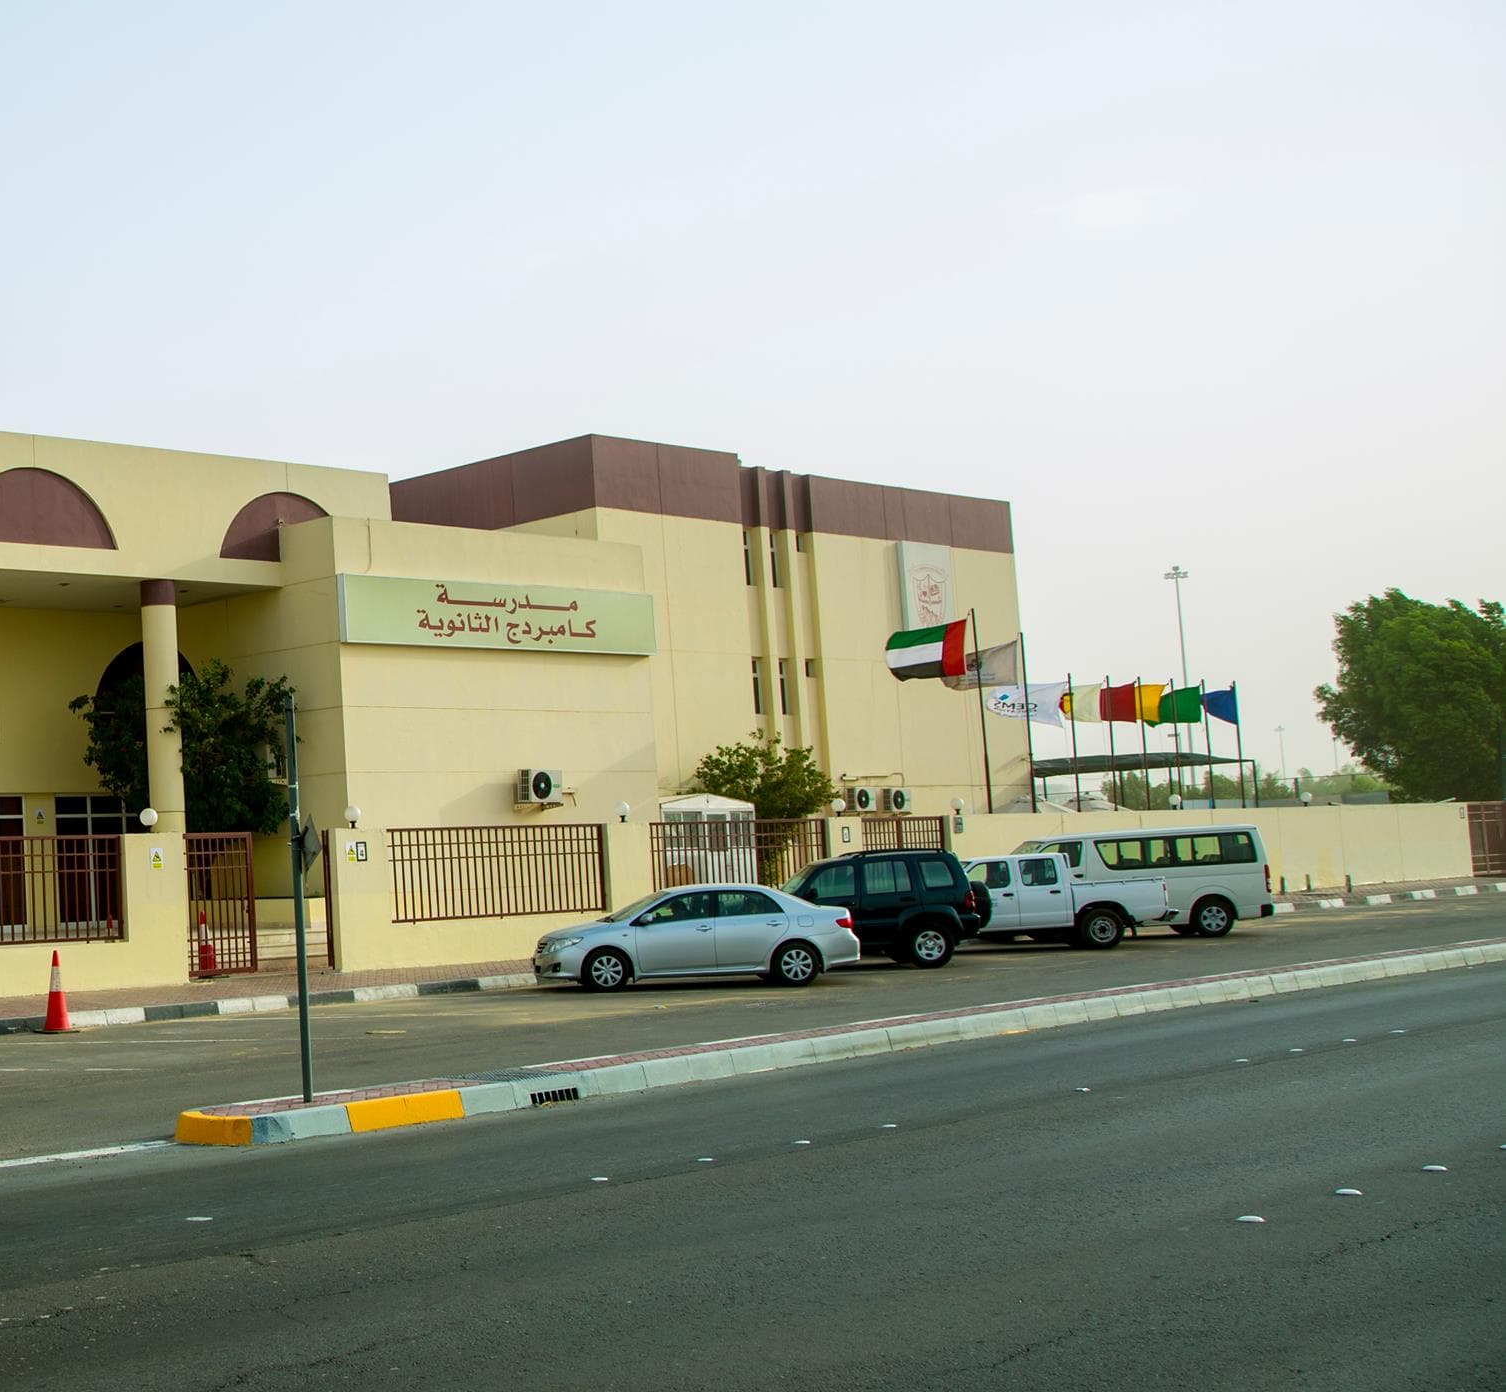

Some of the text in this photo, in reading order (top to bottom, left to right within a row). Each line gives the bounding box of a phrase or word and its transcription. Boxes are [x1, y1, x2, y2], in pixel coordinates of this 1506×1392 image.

[436, 584, 577, 613] مدرسة
[417, 610, 596, 644] كامبردج الثانوية
